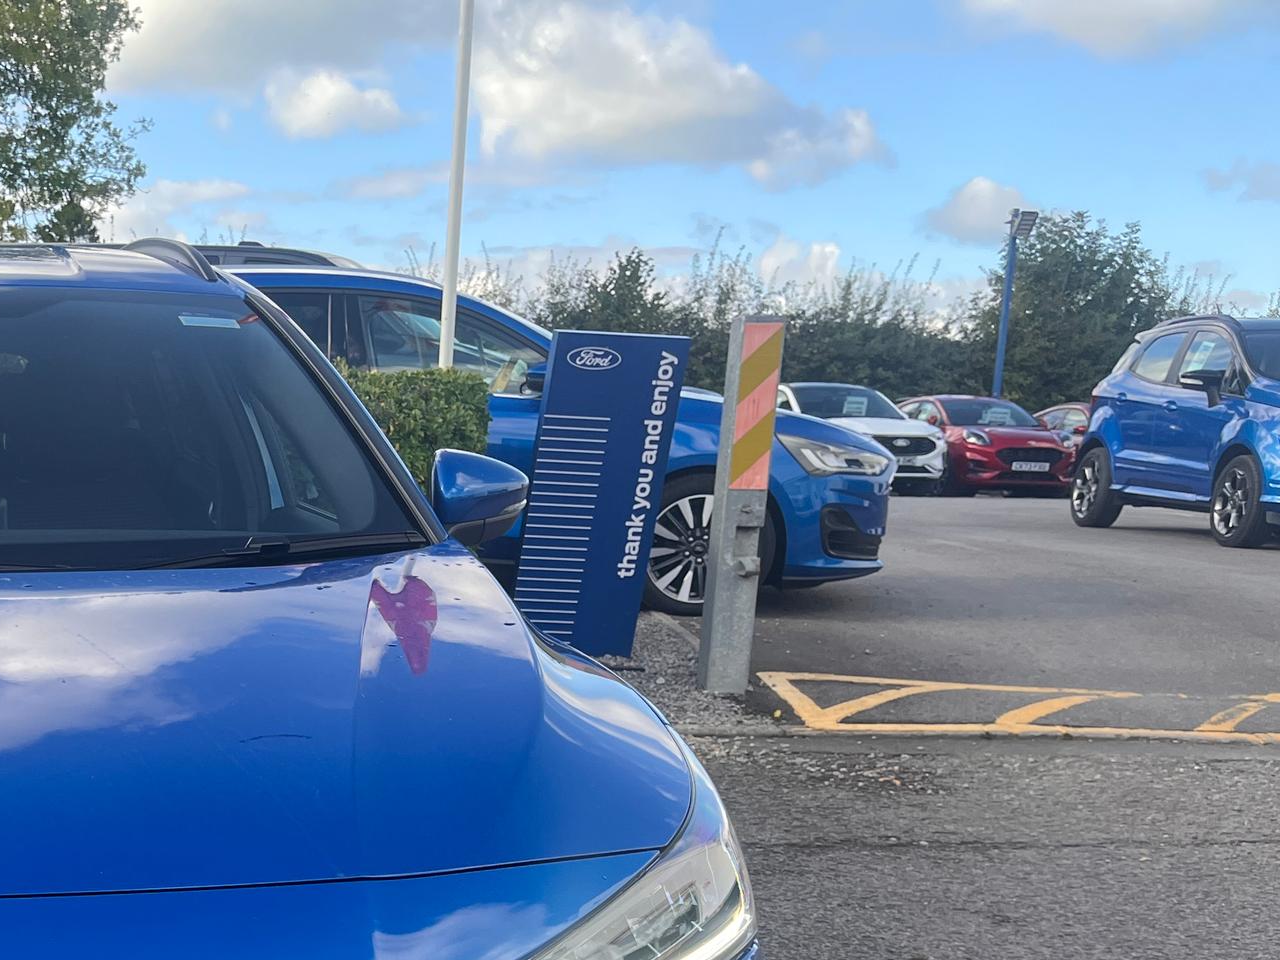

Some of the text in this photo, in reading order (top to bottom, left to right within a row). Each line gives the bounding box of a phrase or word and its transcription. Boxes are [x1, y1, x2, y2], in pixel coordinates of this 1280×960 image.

[575, 349, 613, 367] Ford
[617, 350, 679, 579] thank you and enjoy
